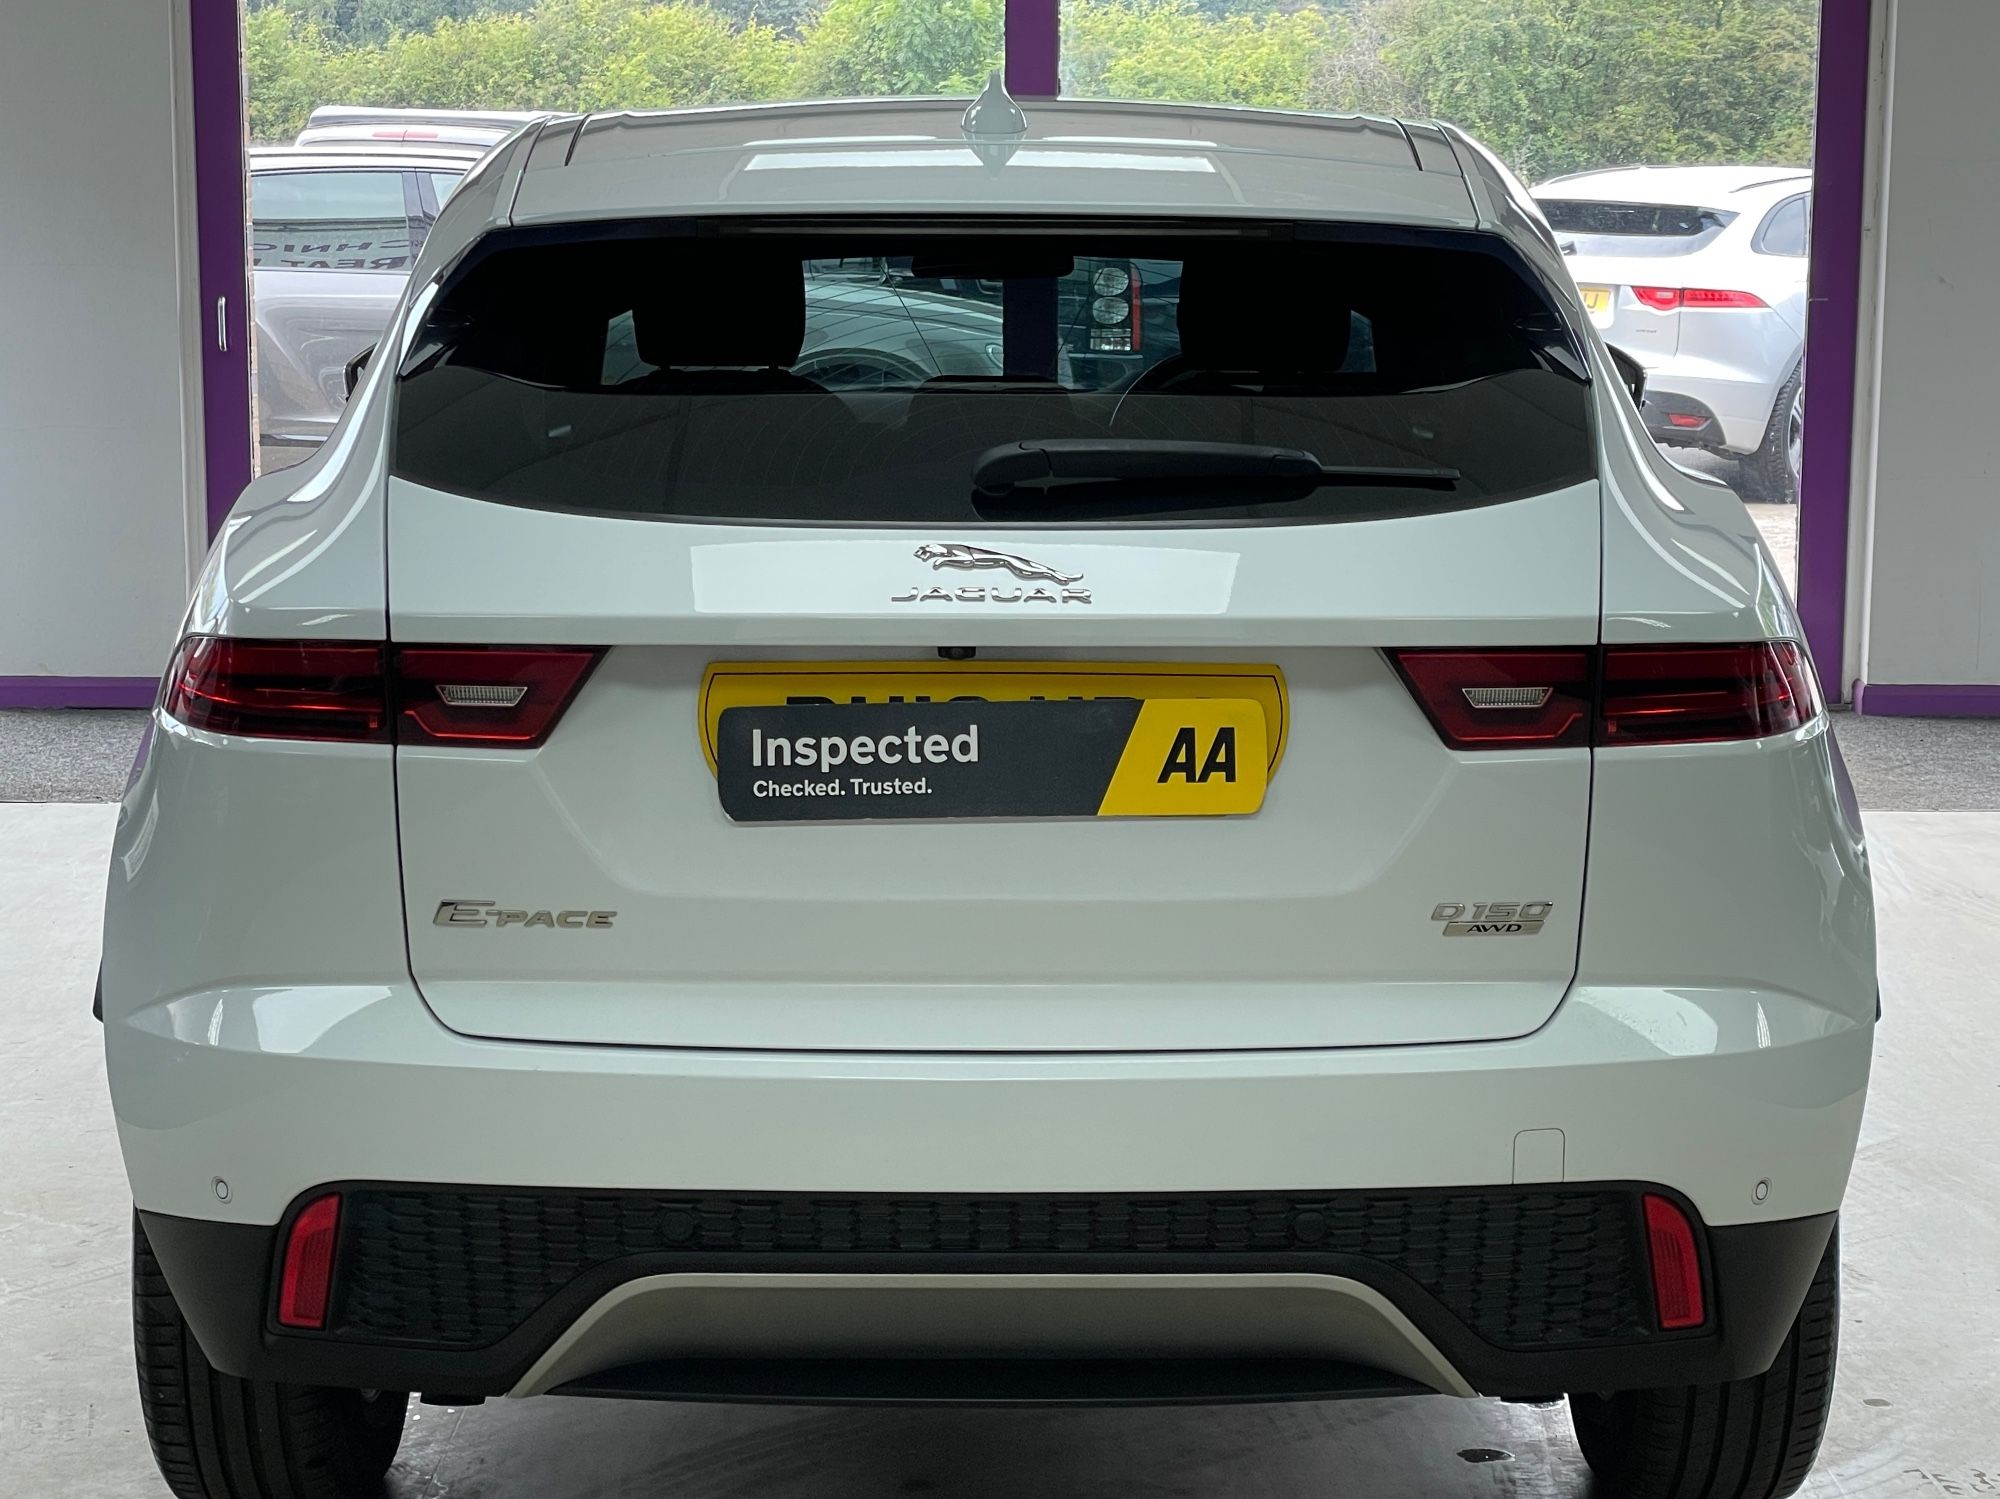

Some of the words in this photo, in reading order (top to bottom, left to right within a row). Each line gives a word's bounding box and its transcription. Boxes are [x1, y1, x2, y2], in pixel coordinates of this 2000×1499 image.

[891, 586, 1092, 604] JAGUAR
[752, 724, 979, 773] Inspected
[1157, 726, 1236, 784] AA
[752, 779, 846, 797] Checked.
[850, 777, 933, 795] Trusted.
[1466, 923, 1522, 933] AWD
